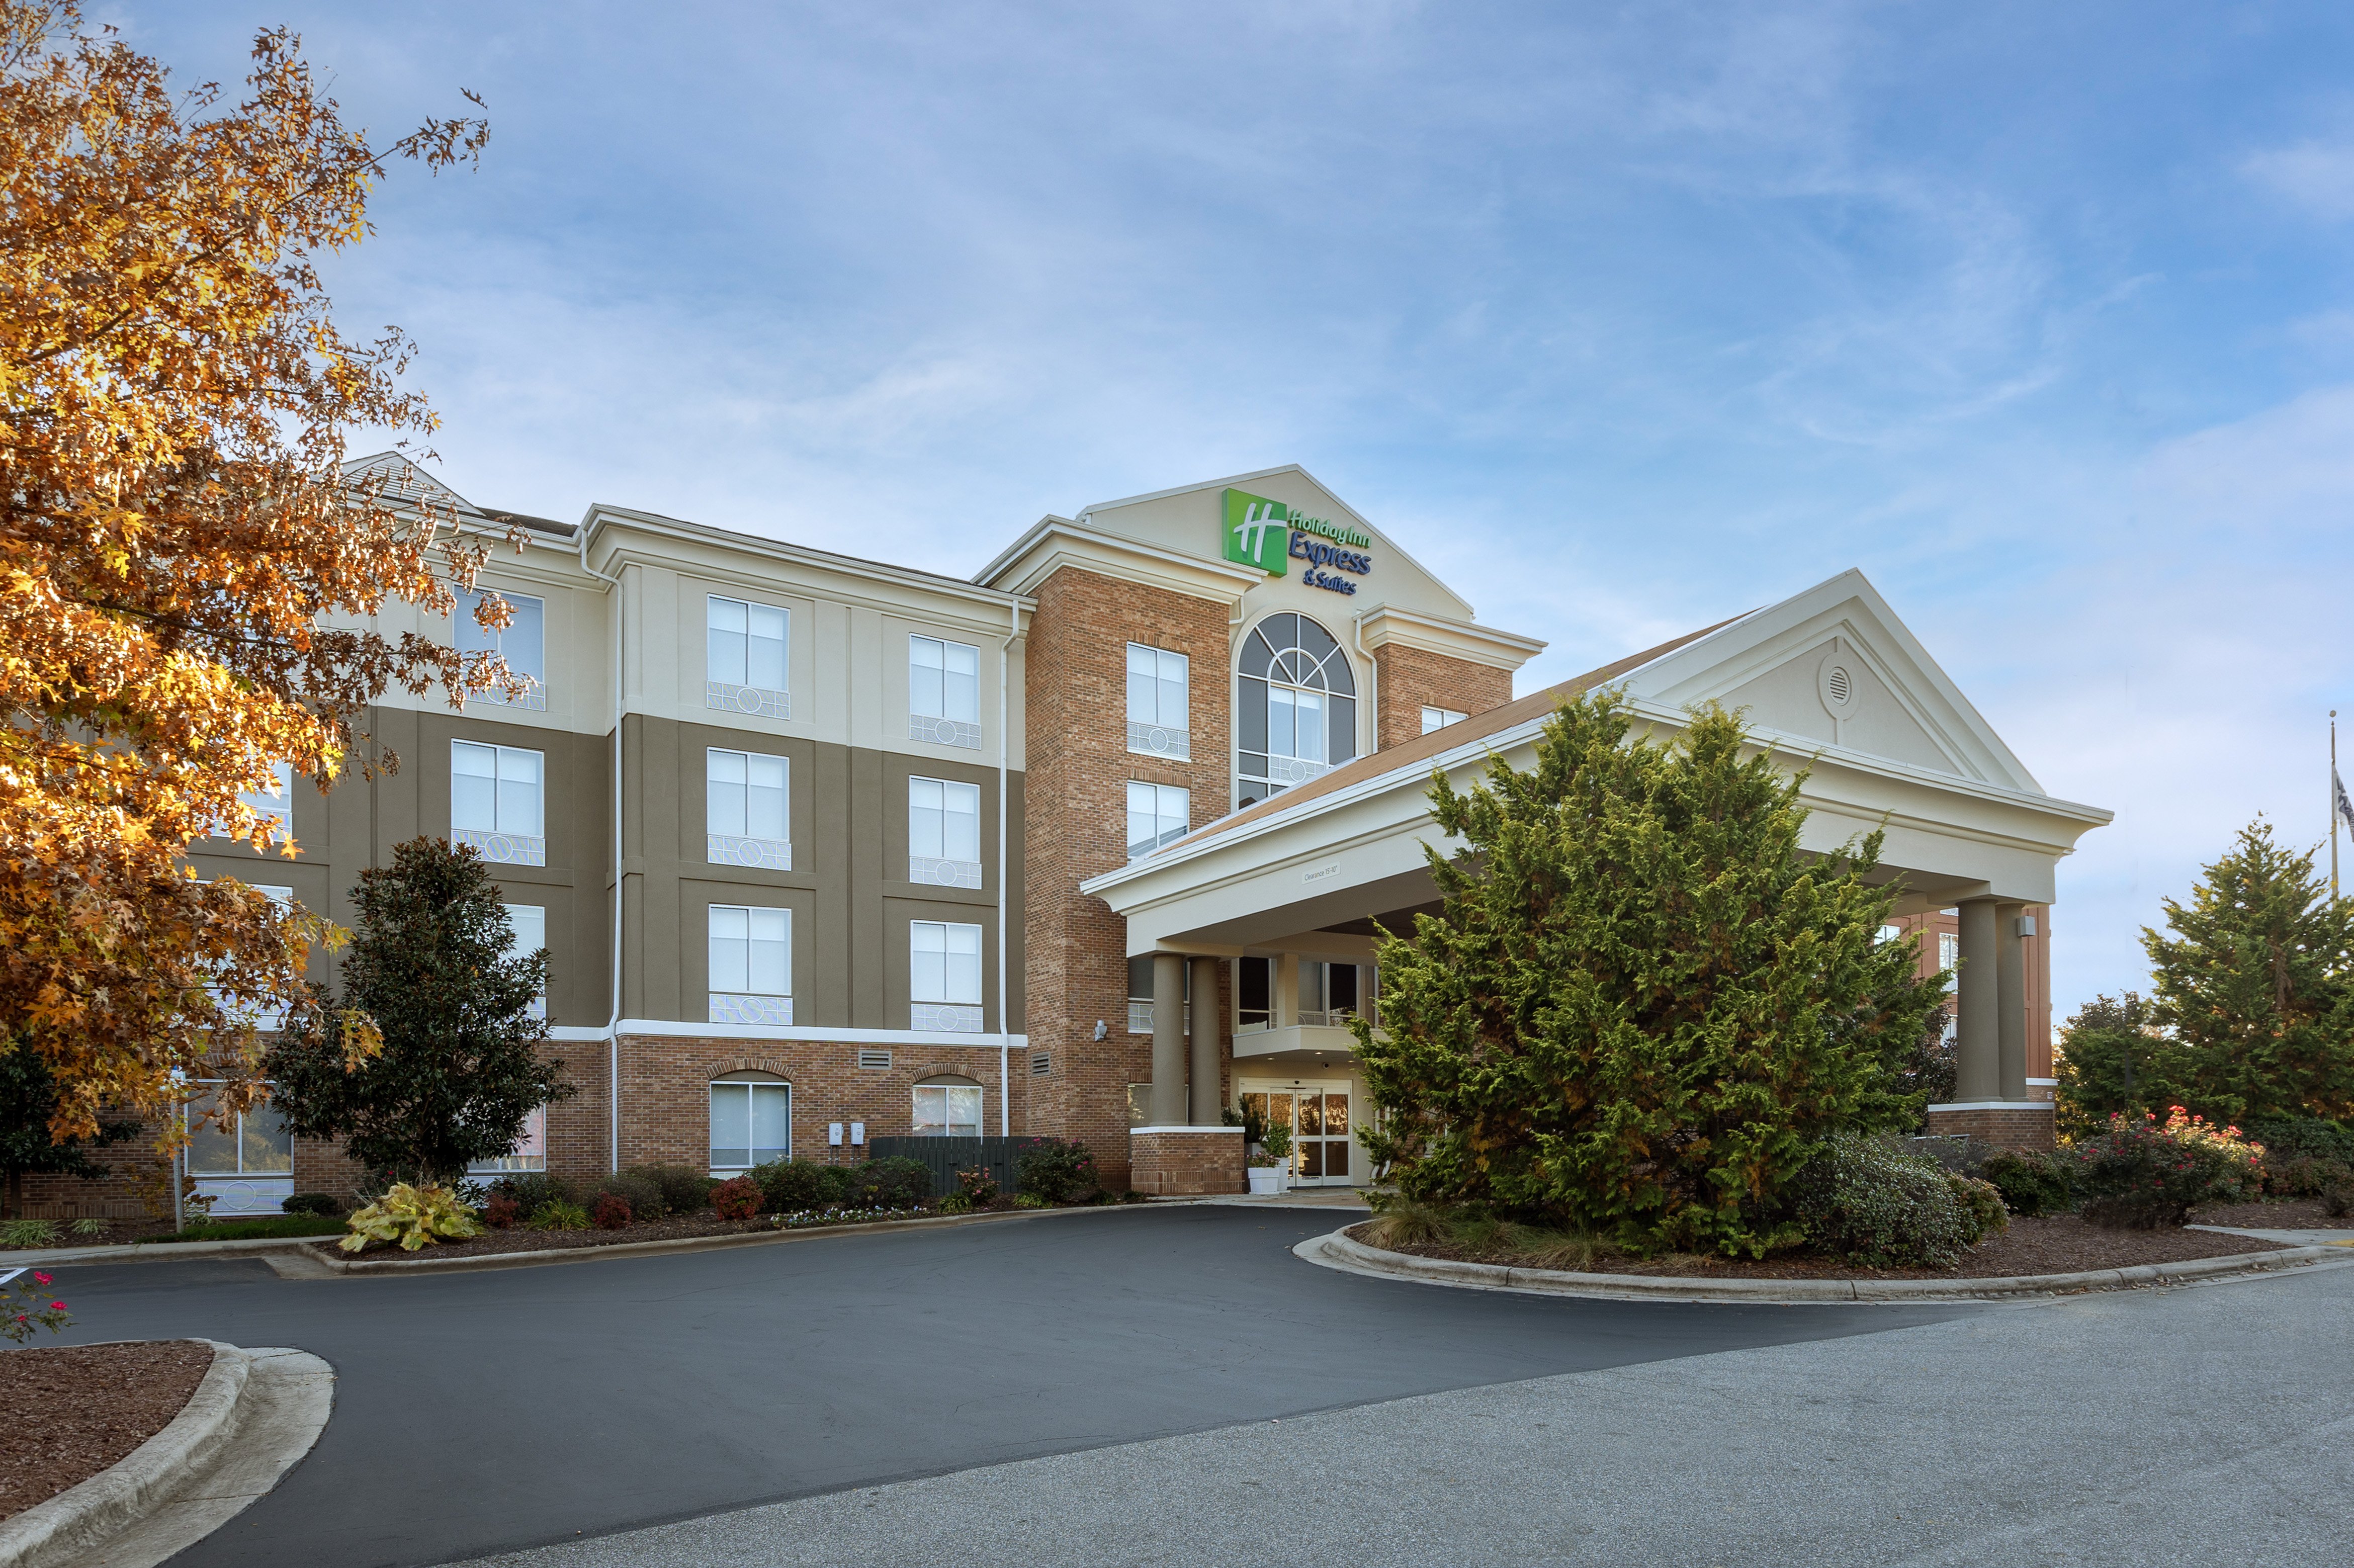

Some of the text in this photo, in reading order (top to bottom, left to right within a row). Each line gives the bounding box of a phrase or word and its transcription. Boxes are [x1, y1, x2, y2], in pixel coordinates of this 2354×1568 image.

[1289, 509, 1371, 549] Holiday Inn
[1289, 531, 1371, 575] Express
[1303, 568, 1357, 595] & Suites
[1304, 870, 1325, 881] Clearance
